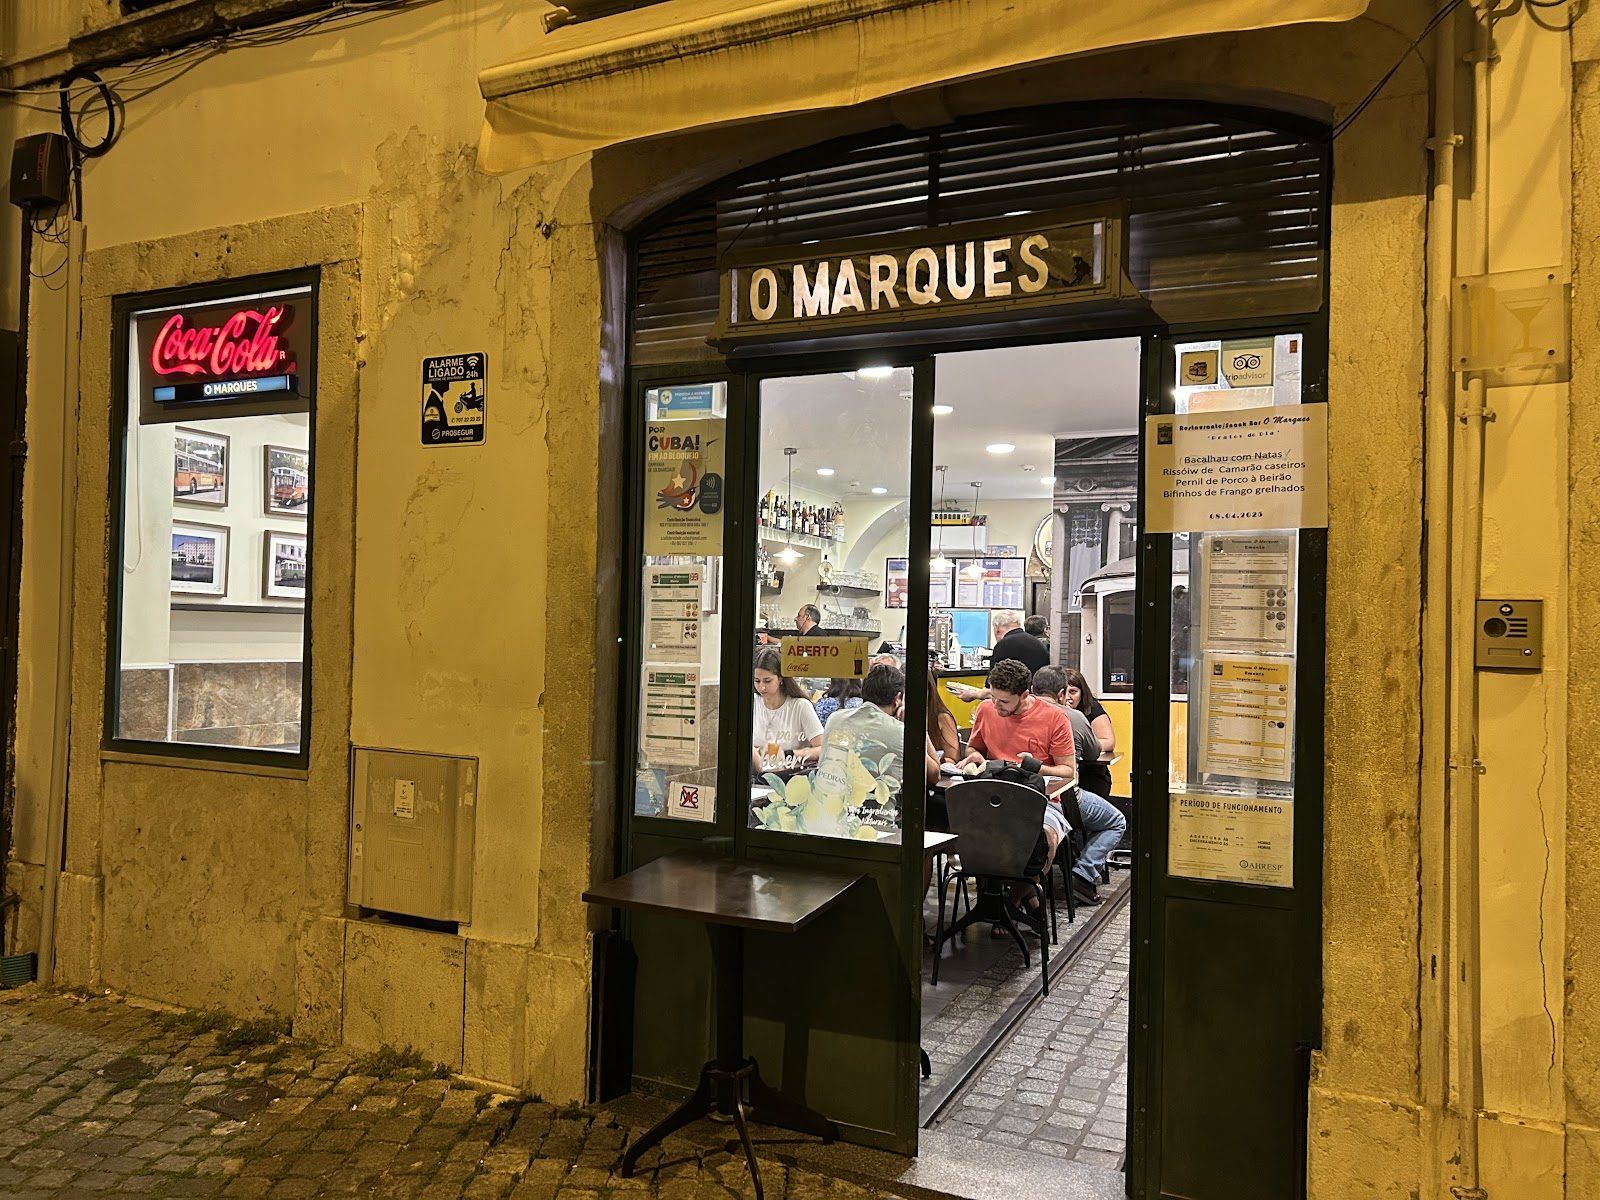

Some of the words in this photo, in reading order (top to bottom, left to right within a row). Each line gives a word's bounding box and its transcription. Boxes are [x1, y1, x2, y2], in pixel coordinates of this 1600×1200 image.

[749, 267, 778, 321] O
[793, 234, 1049, 318] MARQUES
[152, 306, 284, 375] Coca-Cola
[429, 357, 464, 369] ALARME
[428, 366, 465, 378] LIGADO
[466, 370, 479, 379] 24h
[1225, 372, 1267, 381] tripadvisor
[204, 385, 212, 395] O
[213, 380, 258, 395] MARQUES
[1263, 417, 1270, 425] O
[1273, 415, 1311, 425] Marques
[441, 428, 474, 437] PROSEGUR
[648, 426, 666, 434] POR
[648, 434, 700, 452] CUBA!
[1184, 455, 1229, 464] Bacalhau
[1231, 454, 1252, 462] com
[1254, 451, 1283, 459] Natas
[1162, 467, 1199, 476] Rissóiw
[1201, 466, 1213, 474] de
[1218, 463, 1262, 473] Camarão
[1264, 461, 1306, 470] caseiros
[1175, 478, 1203, 487] Pernil
[1205, 477, 1218, 485] de
[1221, 476, 1248, 484] Porco
[1251, 474, 1257, 482] à
[1259, 472, 1292, 481] Beirão
[1163, 489, 1202, 498] Bifinhos
[1204, 488, 1217, 496] de
[1219, 487, 1253, 498] Frango
[1255, 484, 1305, 496] grelhados
[1209, 511, 1263, 520] 08.04.2025
[787, 645, 839, 657] ABERTO
[818, 770, 846, 785] PEDRAS
[1212, 801, 1221, 809] DE
[1223, 802, 1283, 814] FUNCIONAMENTO
[1249, 862, 1282, 871] AHRESP
